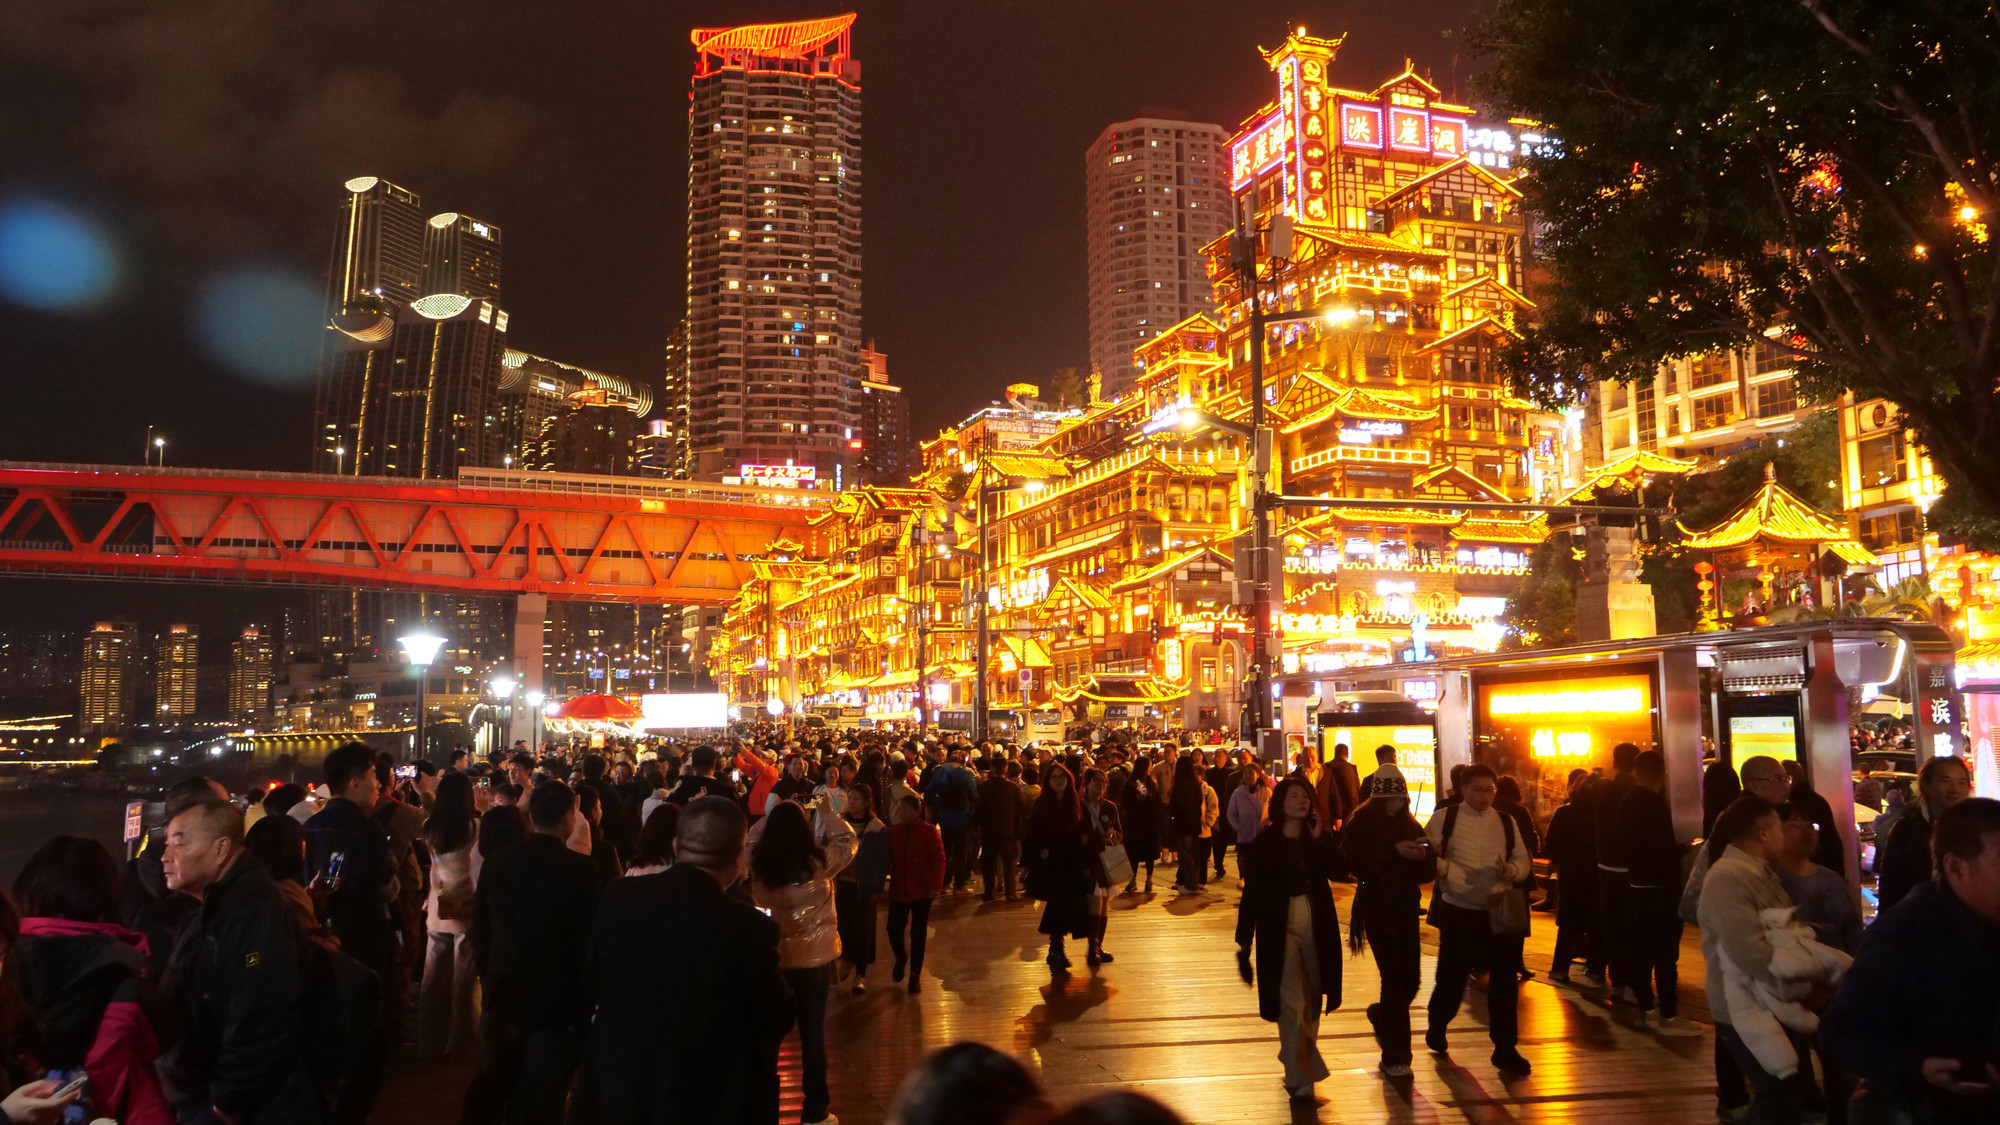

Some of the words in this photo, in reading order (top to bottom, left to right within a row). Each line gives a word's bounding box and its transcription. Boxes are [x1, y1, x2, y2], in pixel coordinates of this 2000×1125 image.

[1235, 123, 1285, 181] 洪崖洞
[1348, 115, 1456, 153] 洪崖洞
